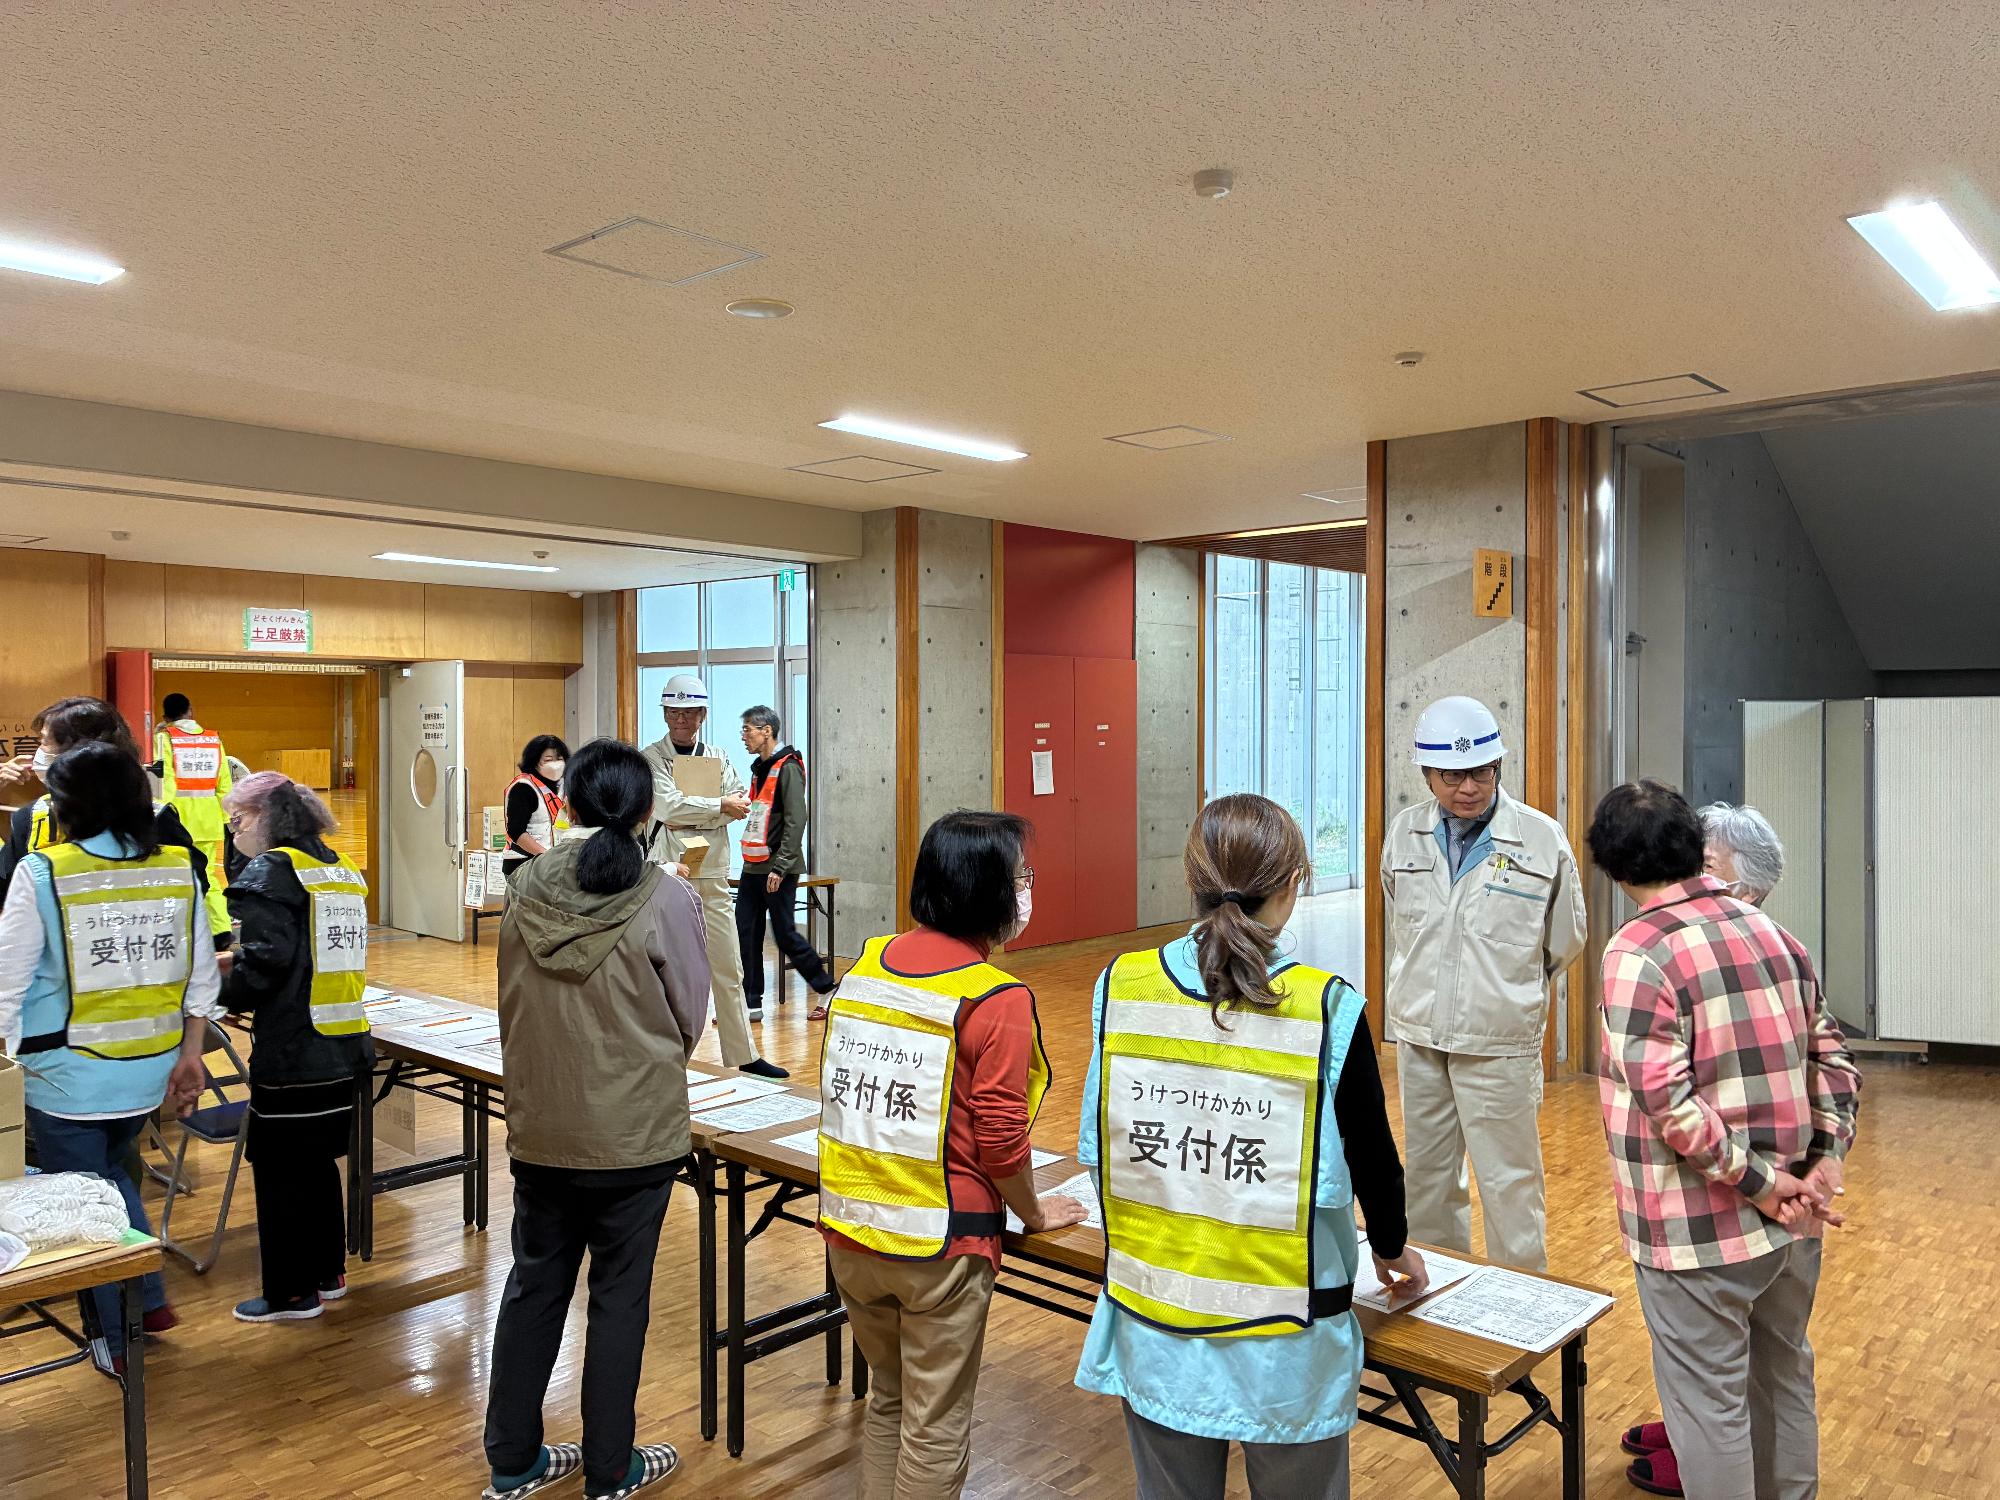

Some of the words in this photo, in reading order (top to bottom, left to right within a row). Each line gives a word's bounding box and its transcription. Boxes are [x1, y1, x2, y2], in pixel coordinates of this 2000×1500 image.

[252, 627, 306, 641] 土足厳禁
[253, 614, 304, 624] どそくげんきん
[89, 933, 176, 968] 受付係
[838, 1035, 923, 1070] うけつけかかり
[830, 1067, 918, 1122] 受付係
[1131, 1080, 1272, 1121] うけつけかかり
[1128, 1119, 1268, 1185] 受付係
